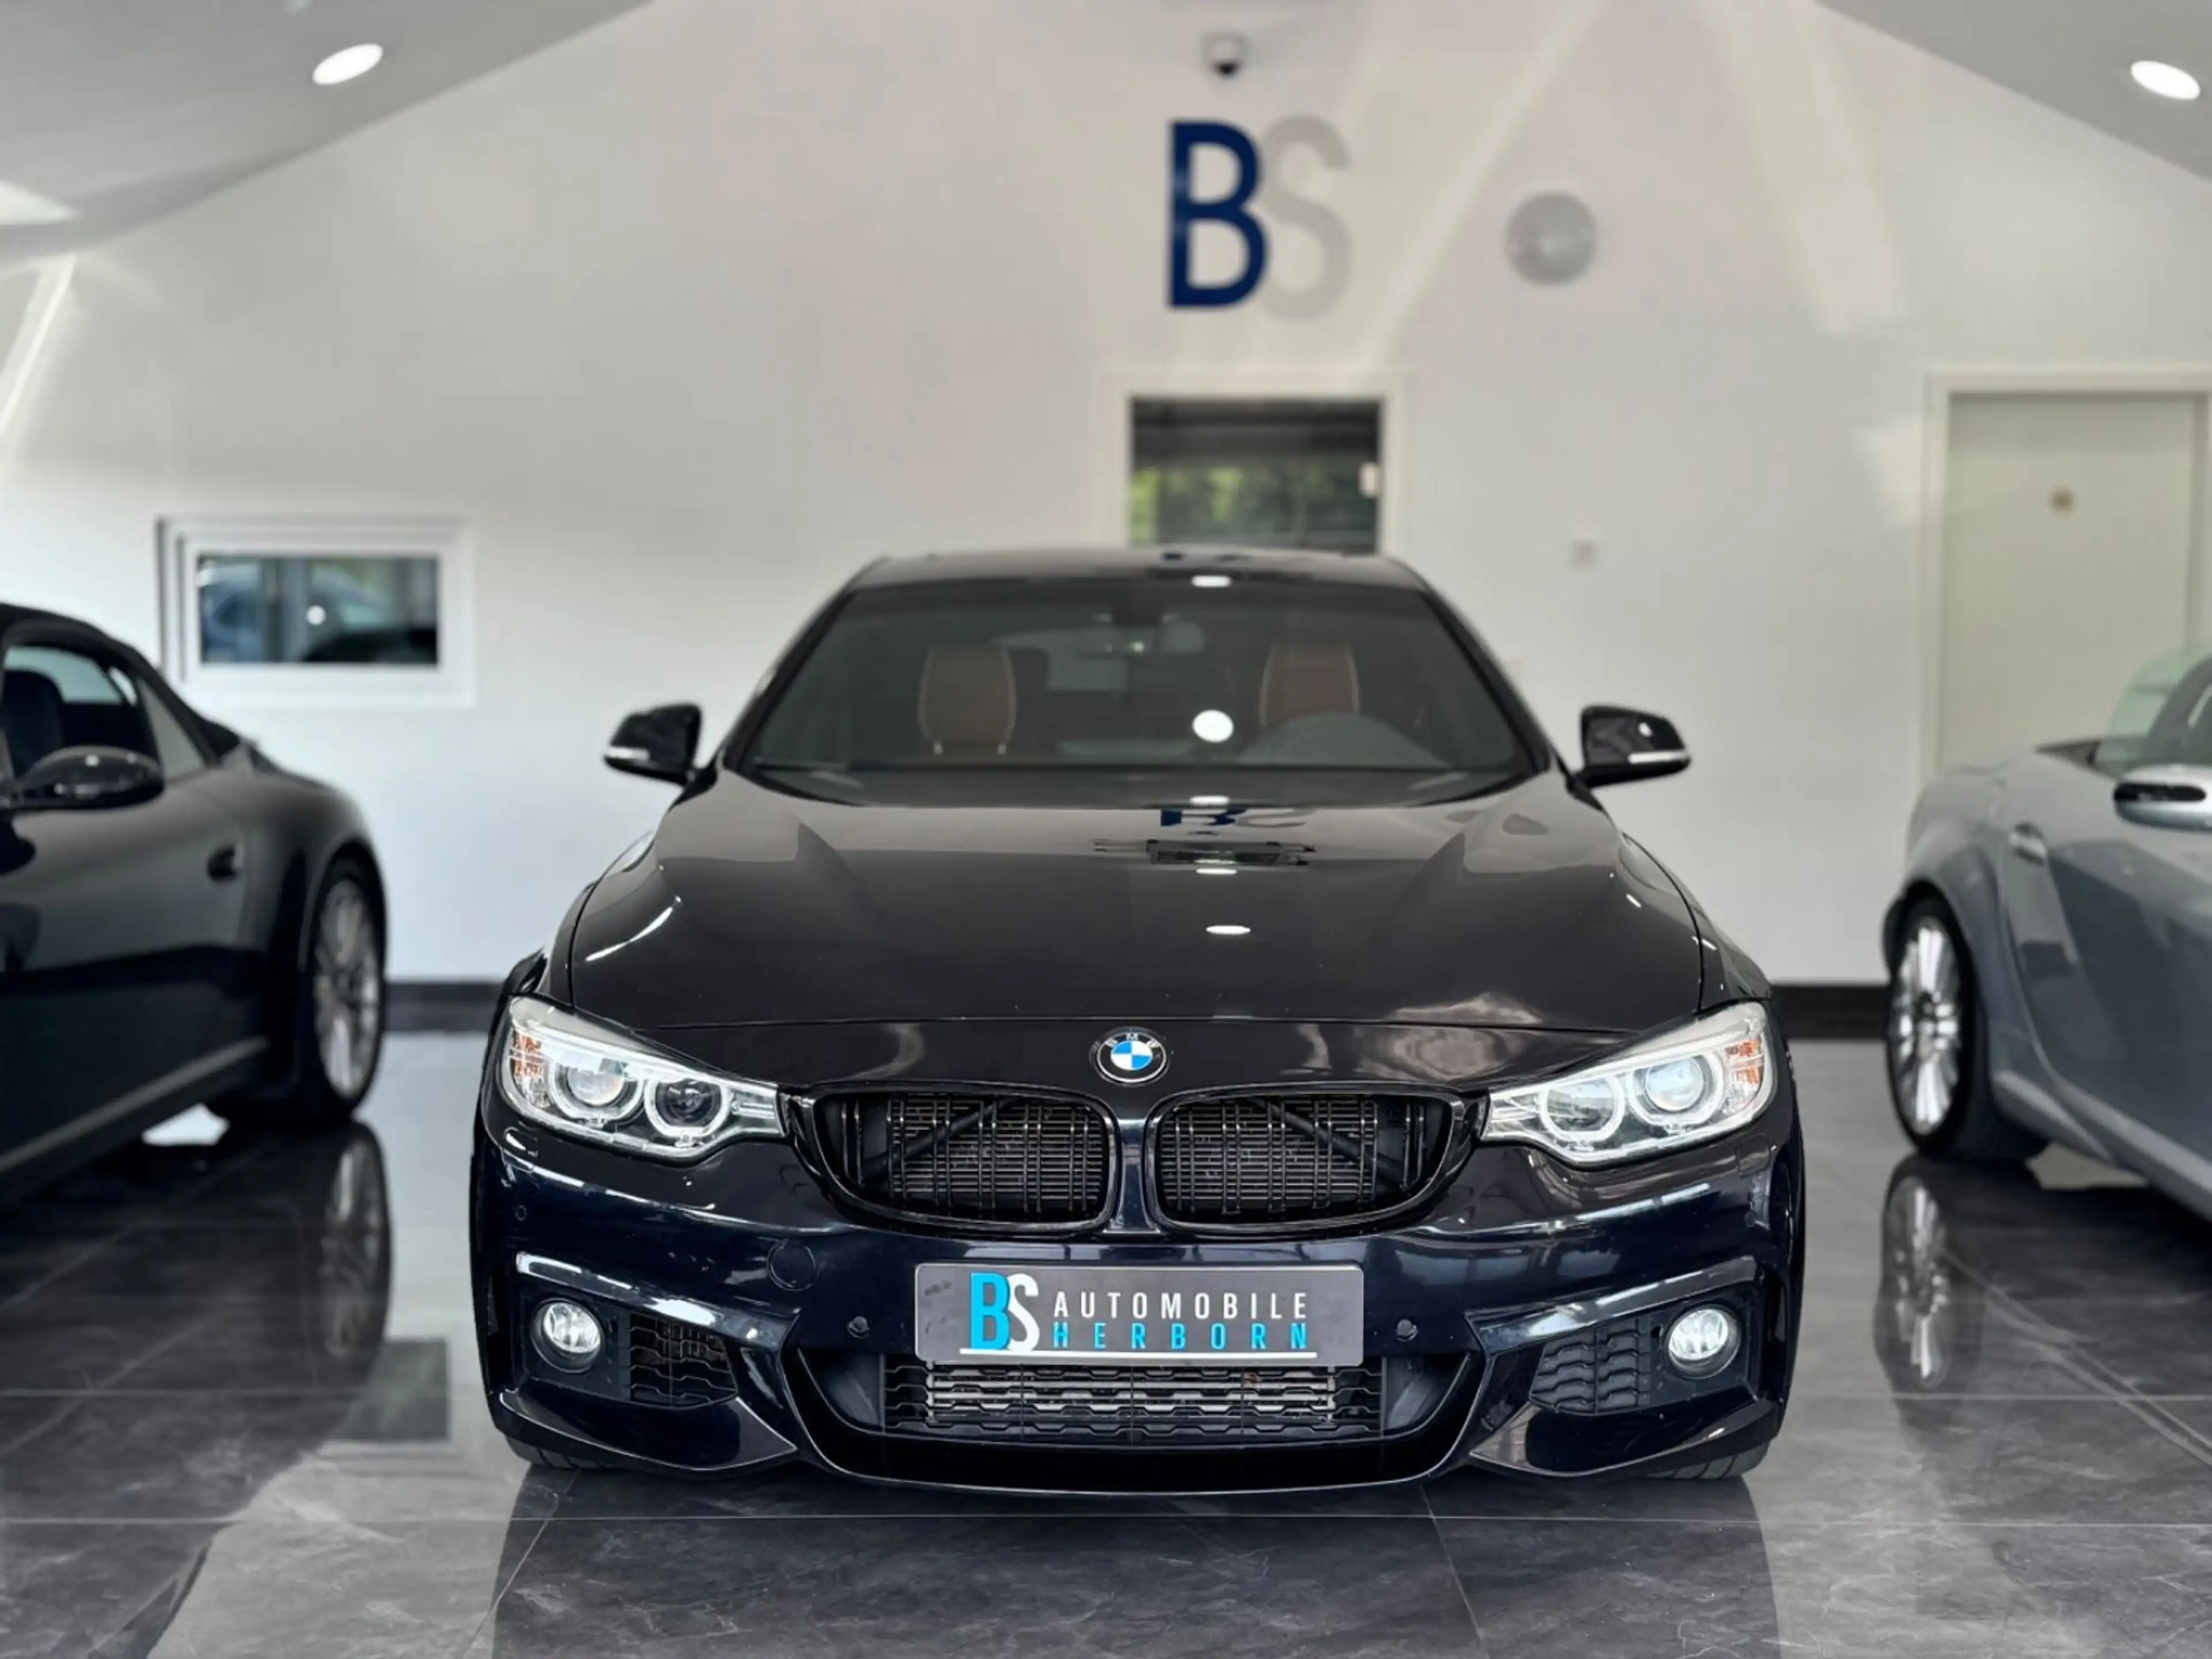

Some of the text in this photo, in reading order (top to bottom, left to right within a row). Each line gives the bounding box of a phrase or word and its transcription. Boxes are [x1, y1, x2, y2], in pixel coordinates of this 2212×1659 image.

[1167, 115, 1353, 320] BS
[969, 1272, 1308, 1352] BS AUTOMOBILE
[1053, 1322, 1307, 1350] HERBORN
